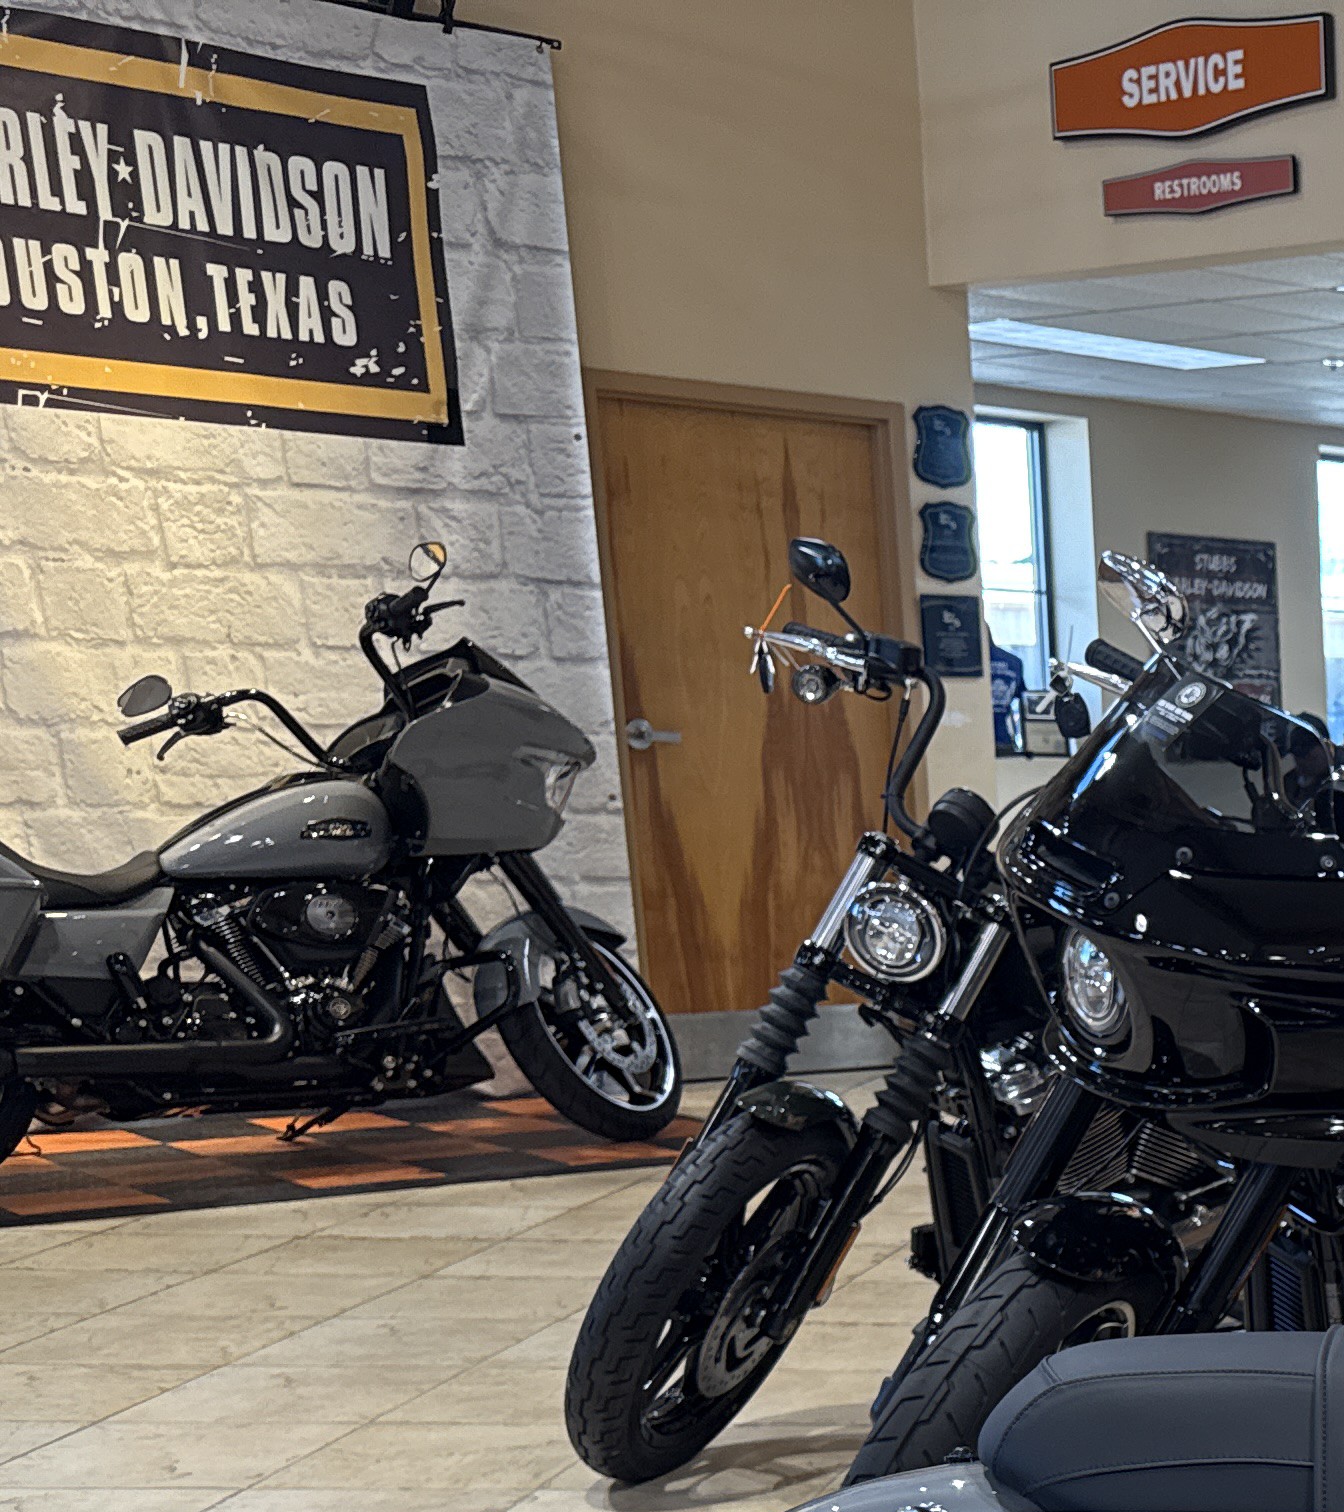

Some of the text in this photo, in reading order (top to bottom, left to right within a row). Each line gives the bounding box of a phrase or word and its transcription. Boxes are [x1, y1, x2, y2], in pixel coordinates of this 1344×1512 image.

[1121, 49, 1246, 108] SERVICE
[133, 128, 393, 259] DAVIDSON
[1153, 171, 1242, 200] RESTROOMS
[206, 262, 358, 347] TEXAS
